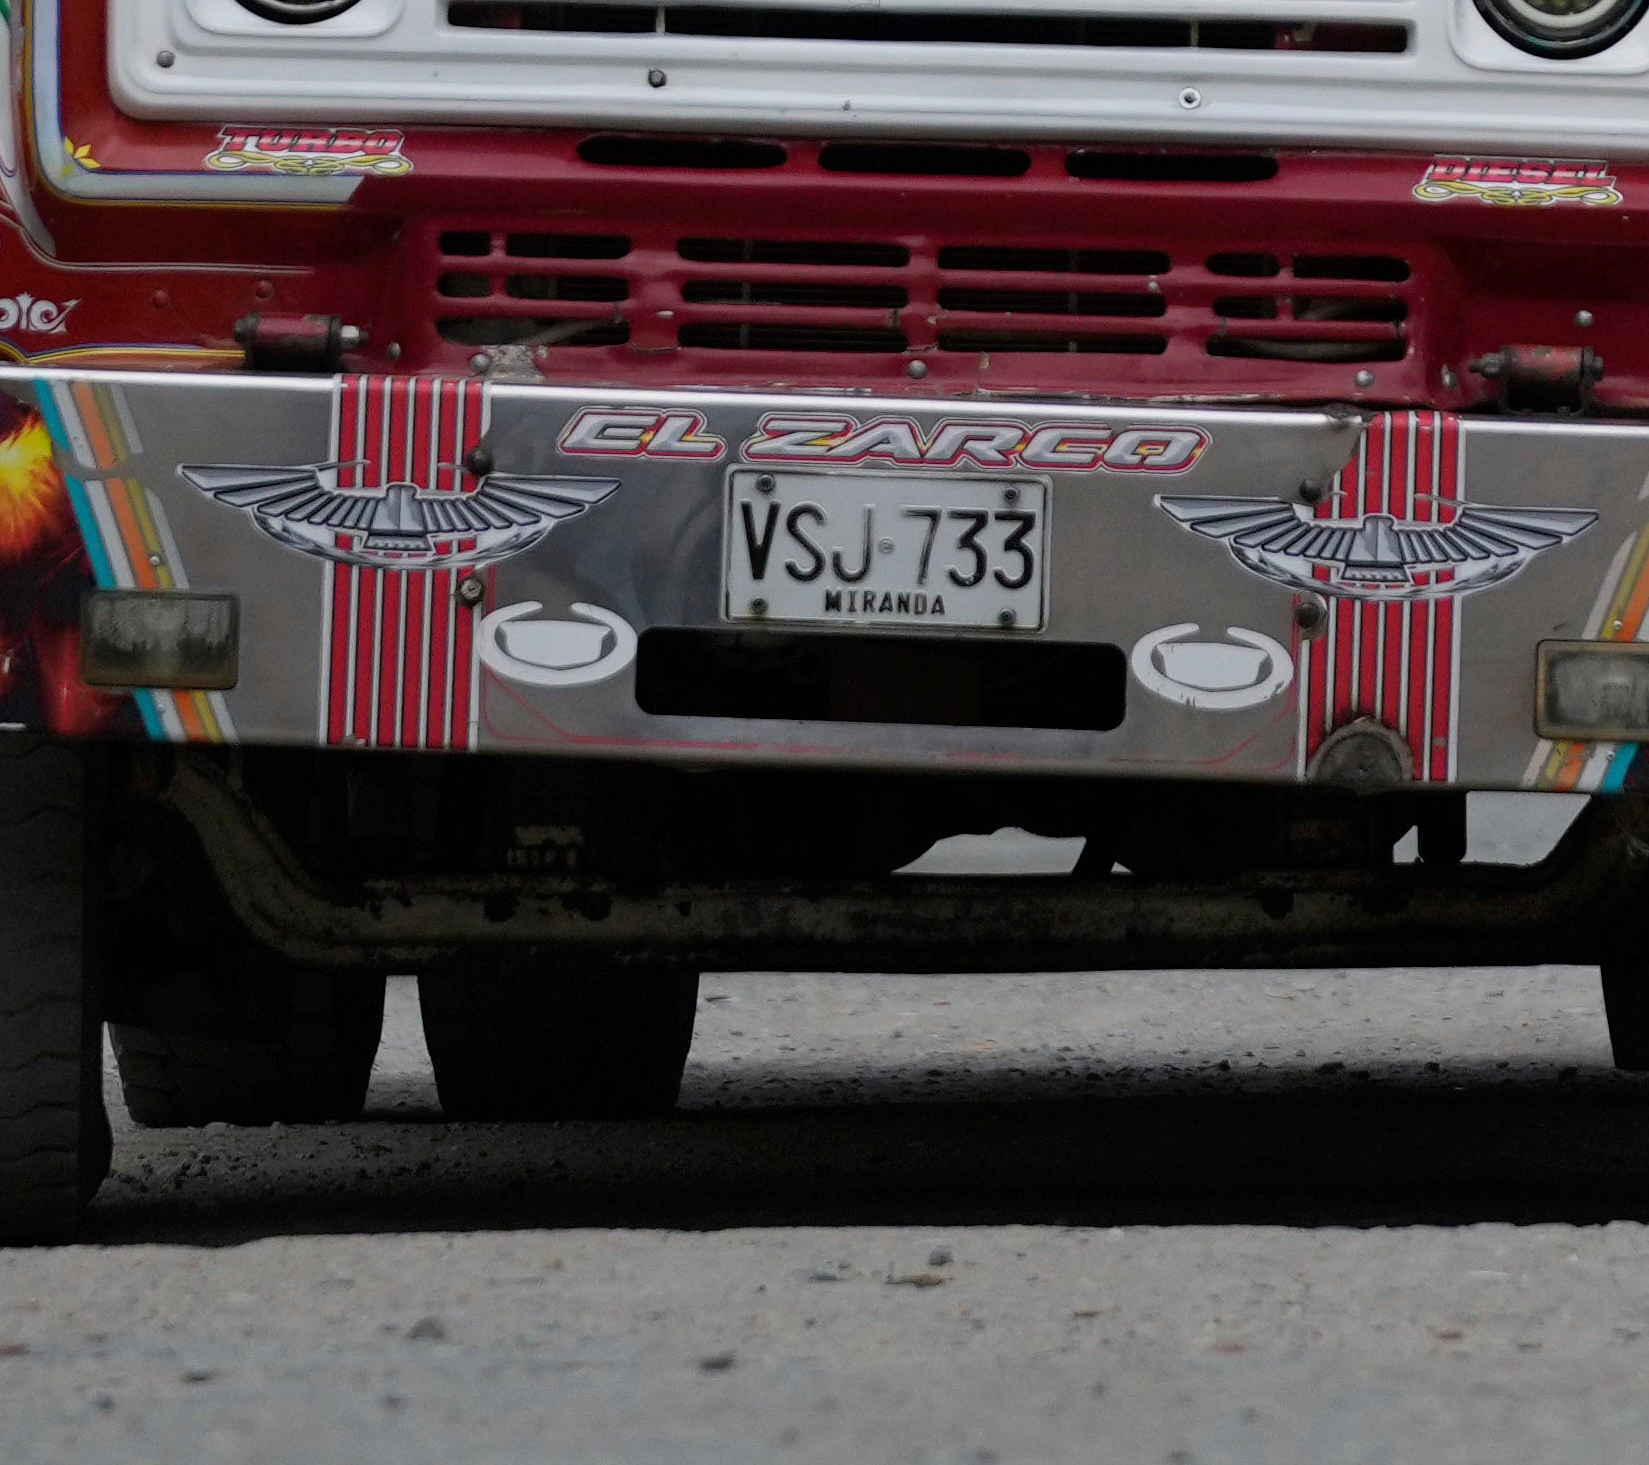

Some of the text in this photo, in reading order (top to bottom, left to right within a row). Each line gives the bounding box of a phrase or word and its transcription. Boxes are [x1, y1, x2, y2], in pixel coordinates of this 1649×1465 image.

[220, 125, 404, 155] TURBO
[1427, 155, 1617, 187] DIESEL
[558, 407, 1212, 475] EL ZARCO
[823, 589, 947, 616] MIRANDA
